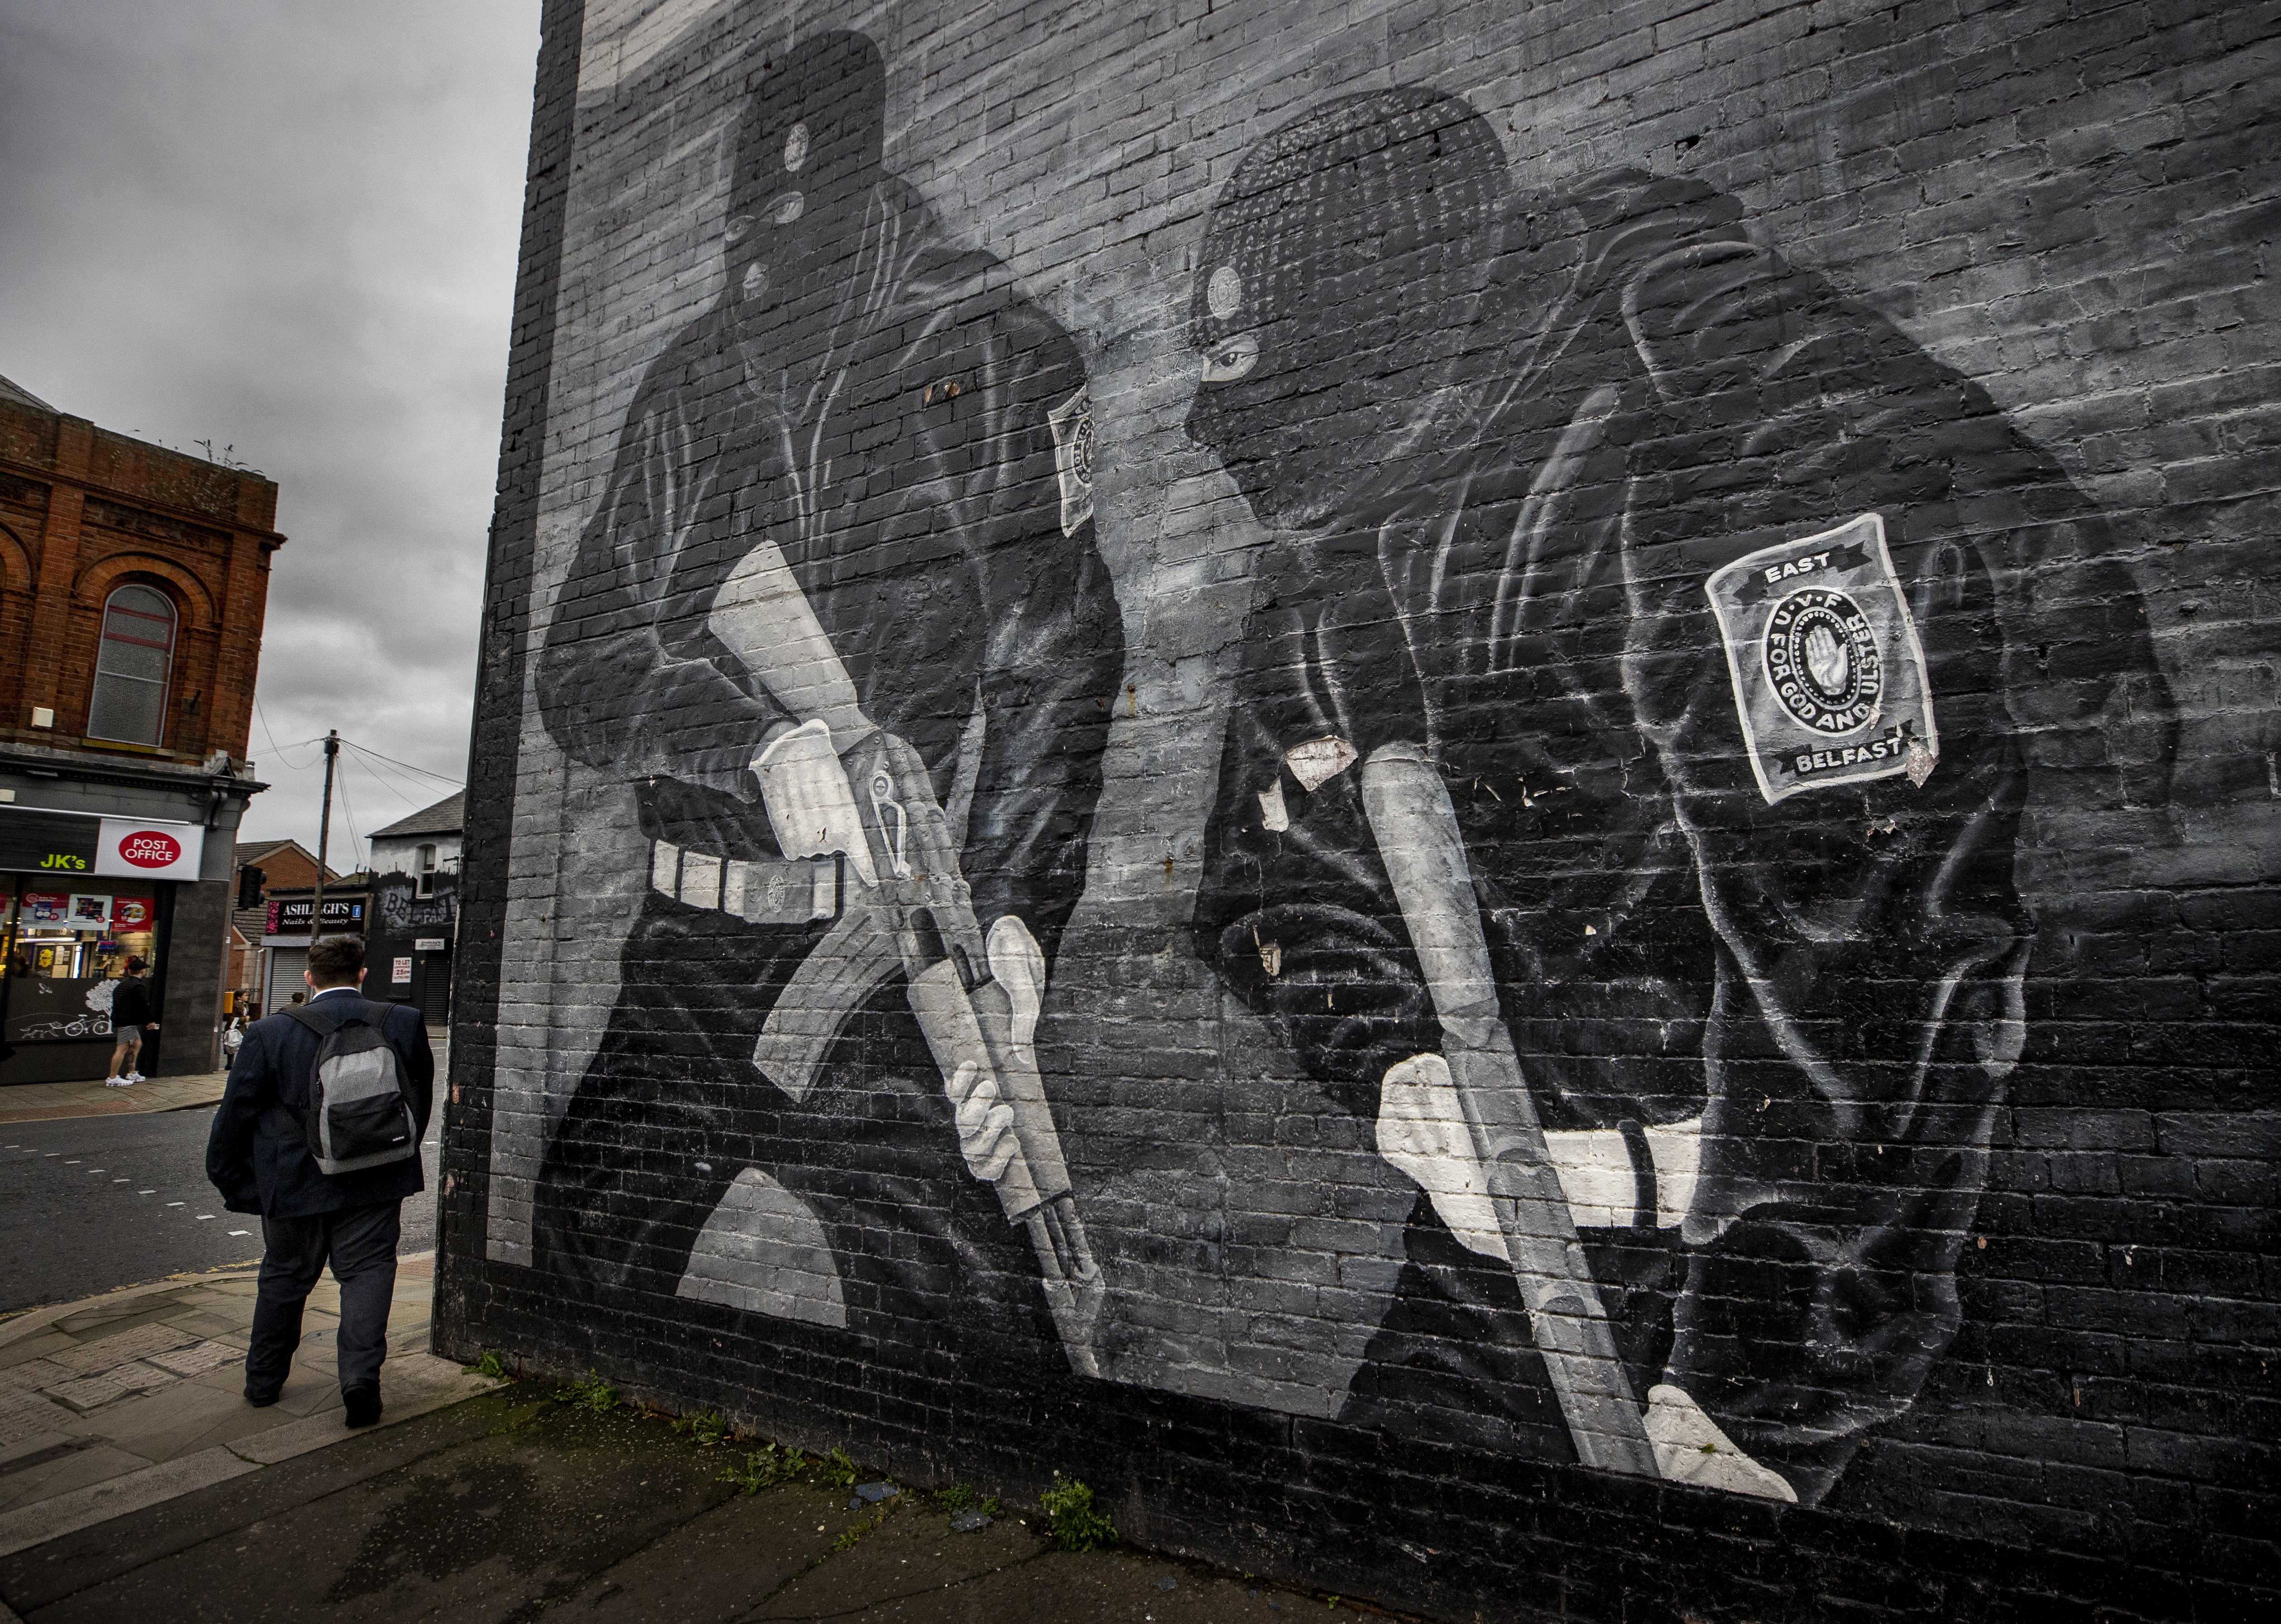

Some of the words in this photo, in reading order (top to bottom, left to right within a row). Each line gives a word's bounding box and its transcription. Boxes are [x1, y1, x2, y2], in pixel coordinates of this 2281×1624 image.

[1765, 552, 1830, 584] EAST
[1770, 633, 1792, 680] FOR
[1781, 682, 1807, 719] GOD
[1816, 703, 1870, 729] AND
[1846, 613, 1879, 695] ULSTER
[1796, 737, 1901, 773] BELFAST
[125, 849, 173, 861] OFFICE
[133, 838, 168, 850] POST
[40, 854, 86, 869] JK's
